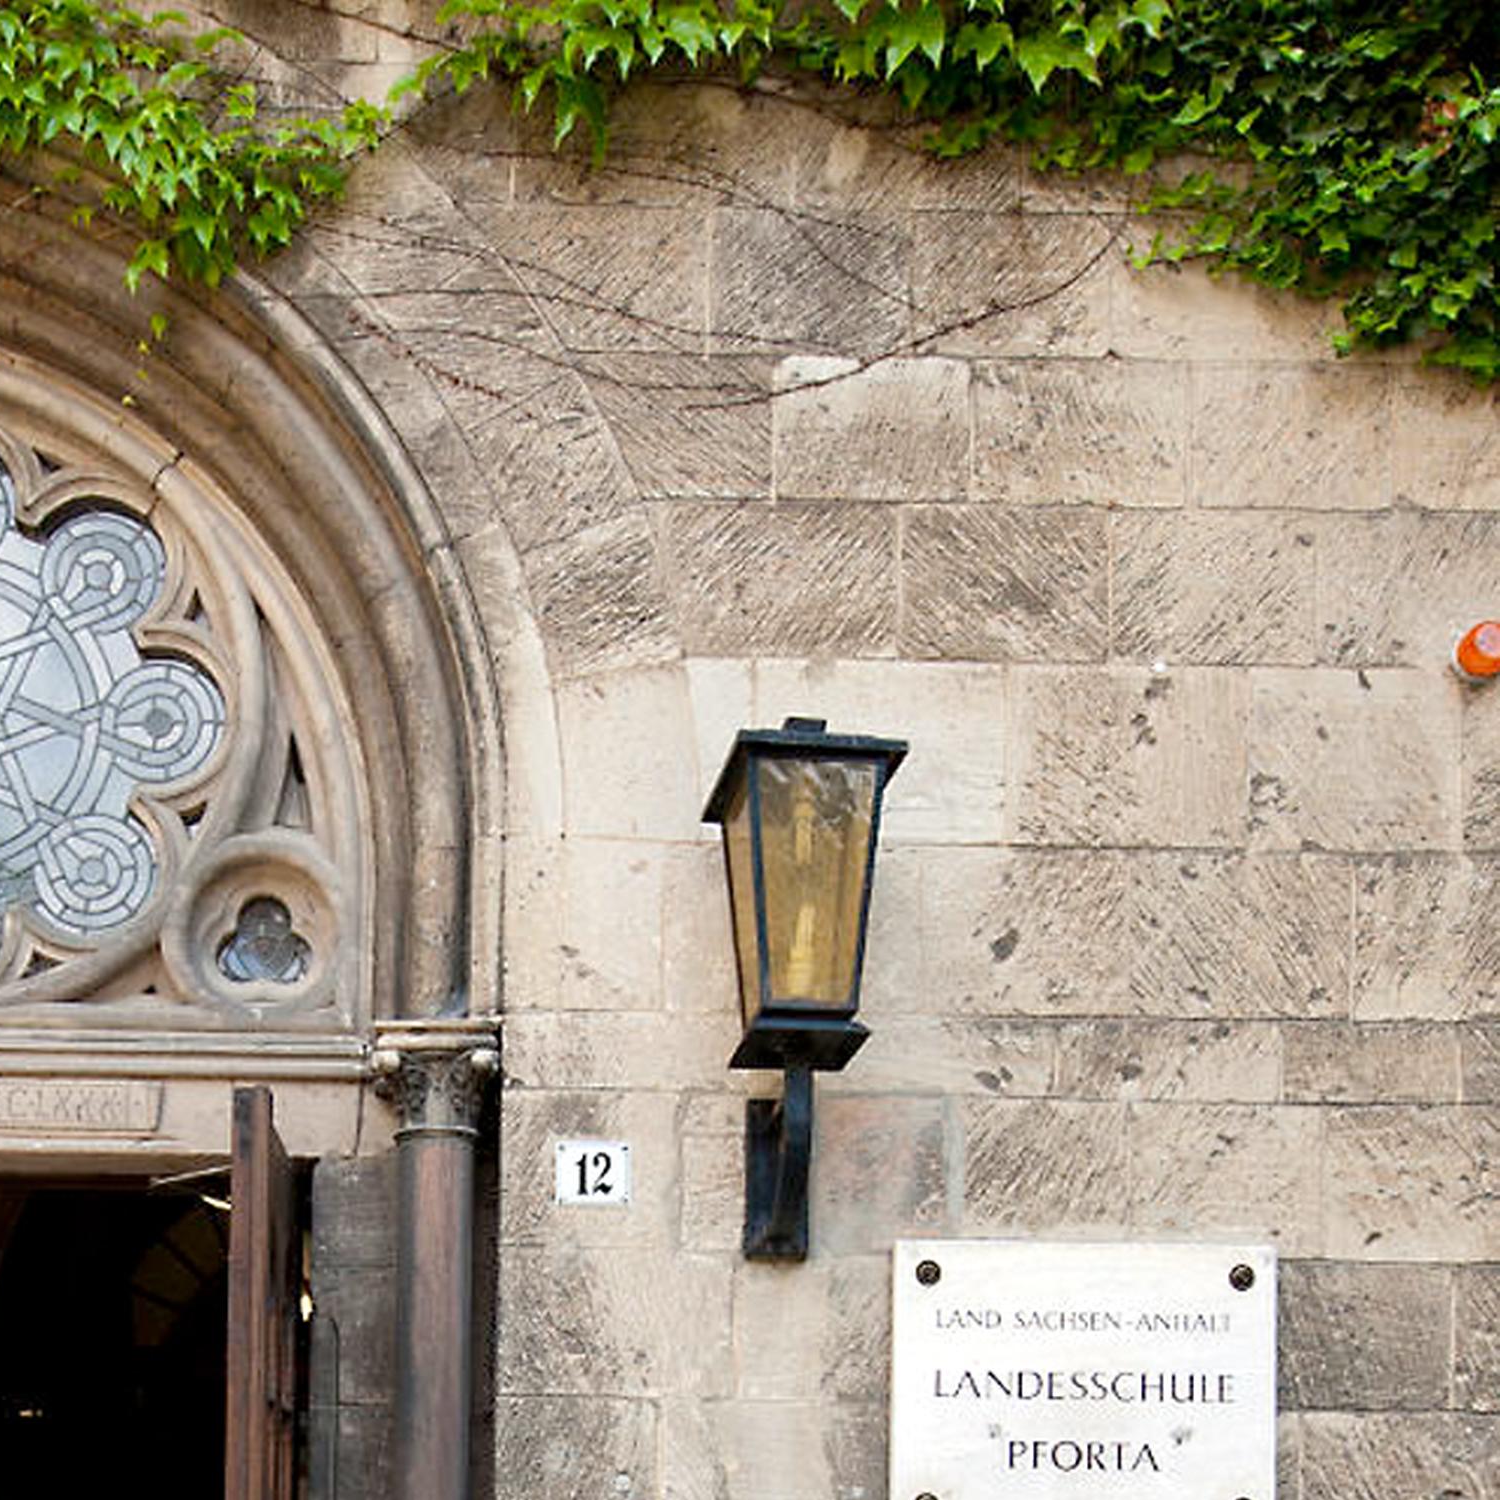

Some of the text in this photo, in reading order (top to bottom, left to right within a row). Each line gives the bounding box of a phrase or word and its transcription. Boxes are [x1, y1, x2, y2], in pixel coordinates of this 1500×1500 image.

[575, 1152, 613, 1195] 12
[935, 1308, 1231, 1334] LAND SACHSEN-ANHALT
[933, 1369, 1236, 1404] LANDESSCHULE
